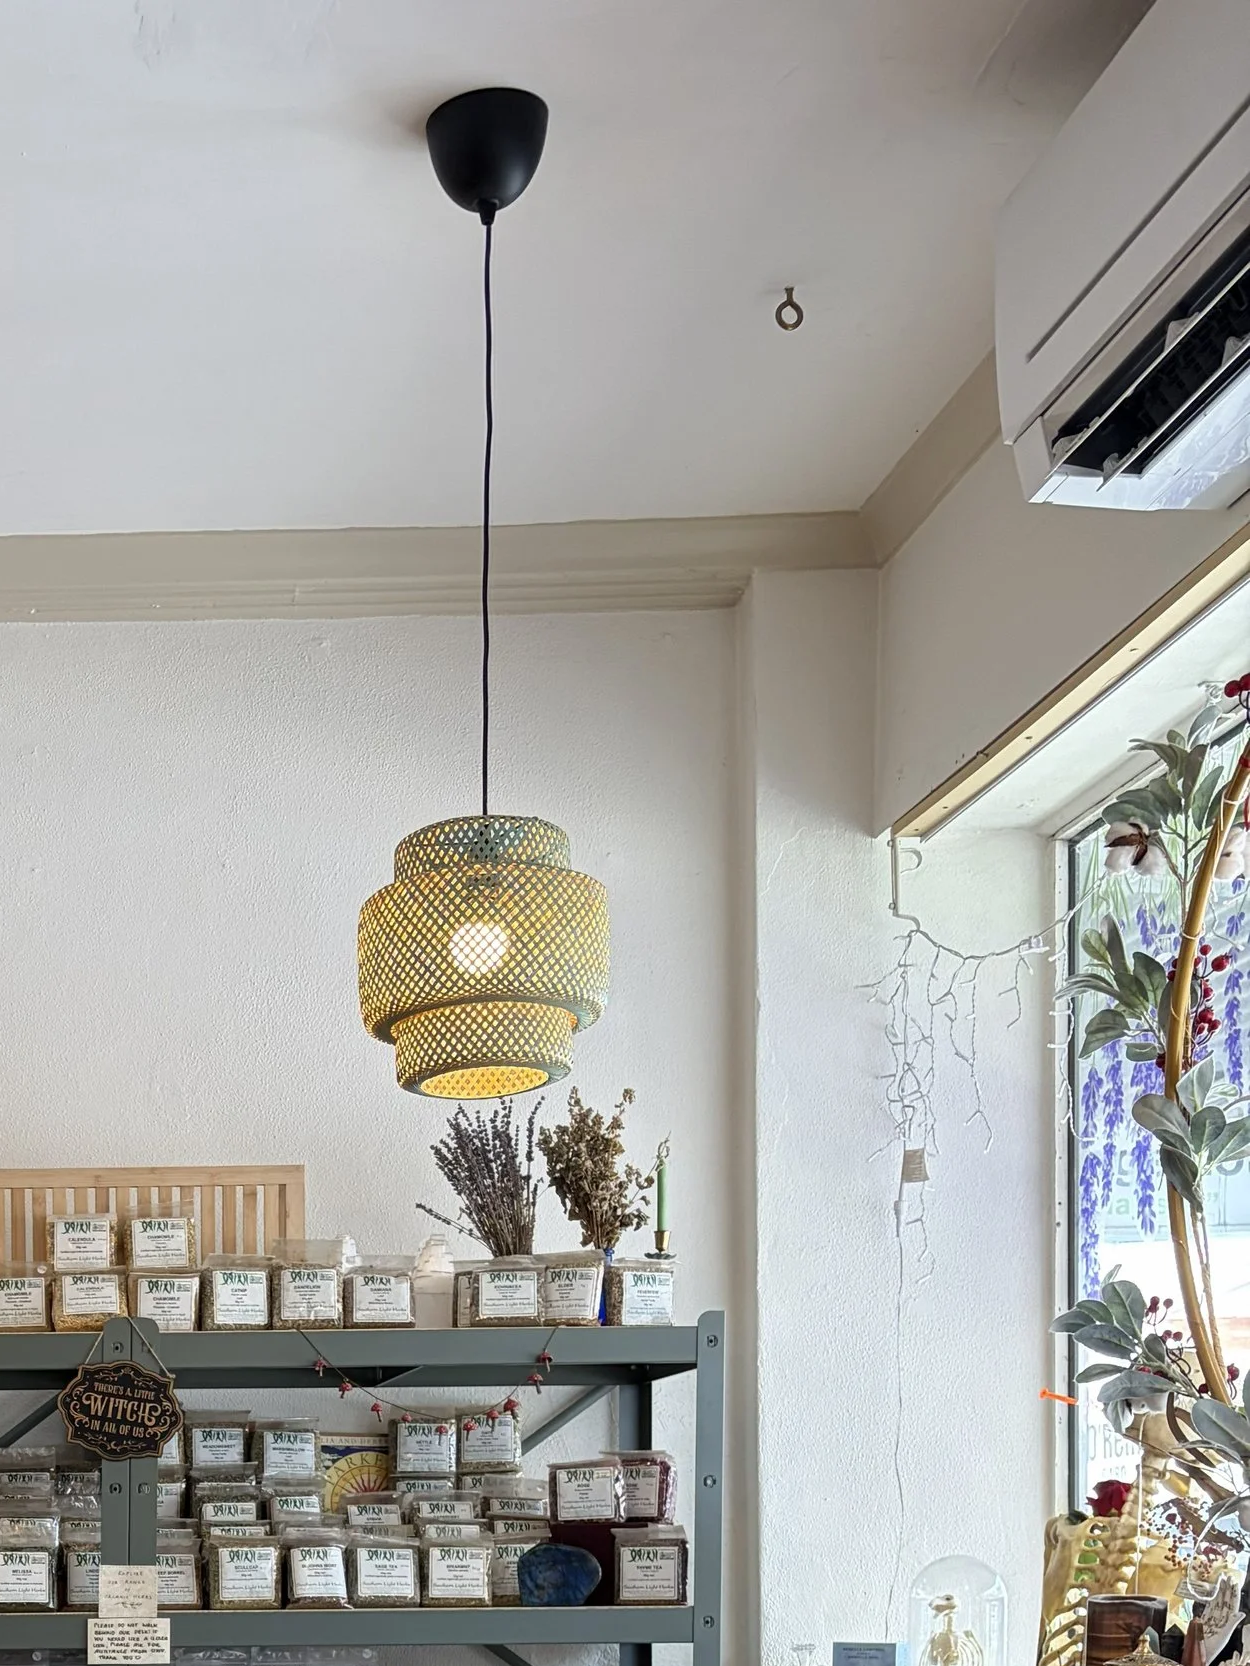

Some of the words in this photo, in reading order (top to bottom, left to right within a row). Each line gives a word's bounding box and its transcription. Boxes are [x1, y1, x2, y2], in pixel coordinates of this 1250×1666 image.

[94, 1382, 124, 1395] THERE'S
[82, 1392, 161, 1426] WITCH
[91, 1420, 100, 1431] IN
[103, 1422, 117, 1433] ALL
[119, 1425, 130, 1435] OF
[133, 1427, 144, 1438] US
